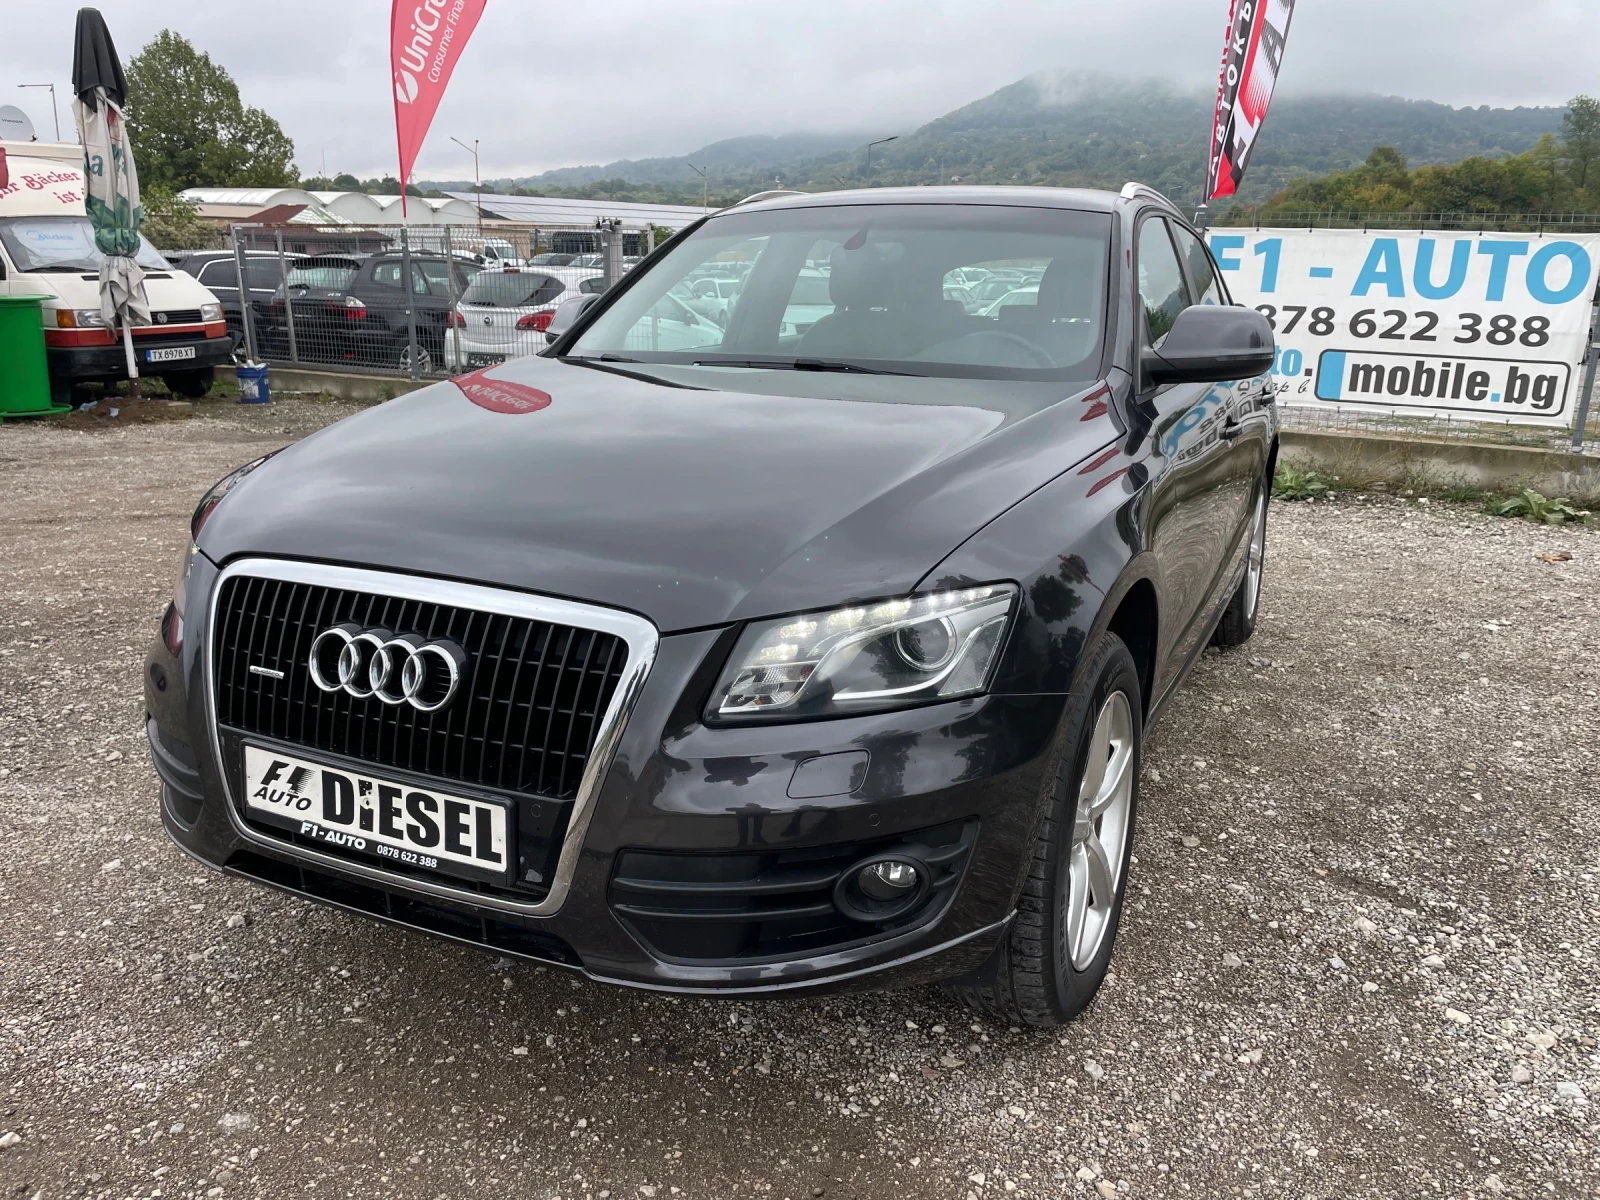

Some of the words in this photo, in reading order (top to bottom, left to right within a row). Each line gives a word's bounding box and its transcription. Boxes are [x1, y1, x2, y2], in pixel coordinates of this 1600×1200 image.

[427, 24, 454, 83] Consumer
[20, 171, 82, 190] Bäcker
[52, 190, 82, 204] ist
[1209, 235, 1283, 293] F1
[1350, 237, 1592, 305] AUTO
[1348, 308, 1439, 342] 622
[1453, 312, 1551, 348] 388
[1348, 359, 1559, 410] mobile.bg
[260, 759, 316, 795] F1
[252, 786, 313, 811] AUTO
[300, 821, 367, 850] F1-AUTO
[376, 844, 400, 860] 0878
[400, 851, 418, 864] 622
[419, 855, 438, 869] 388
